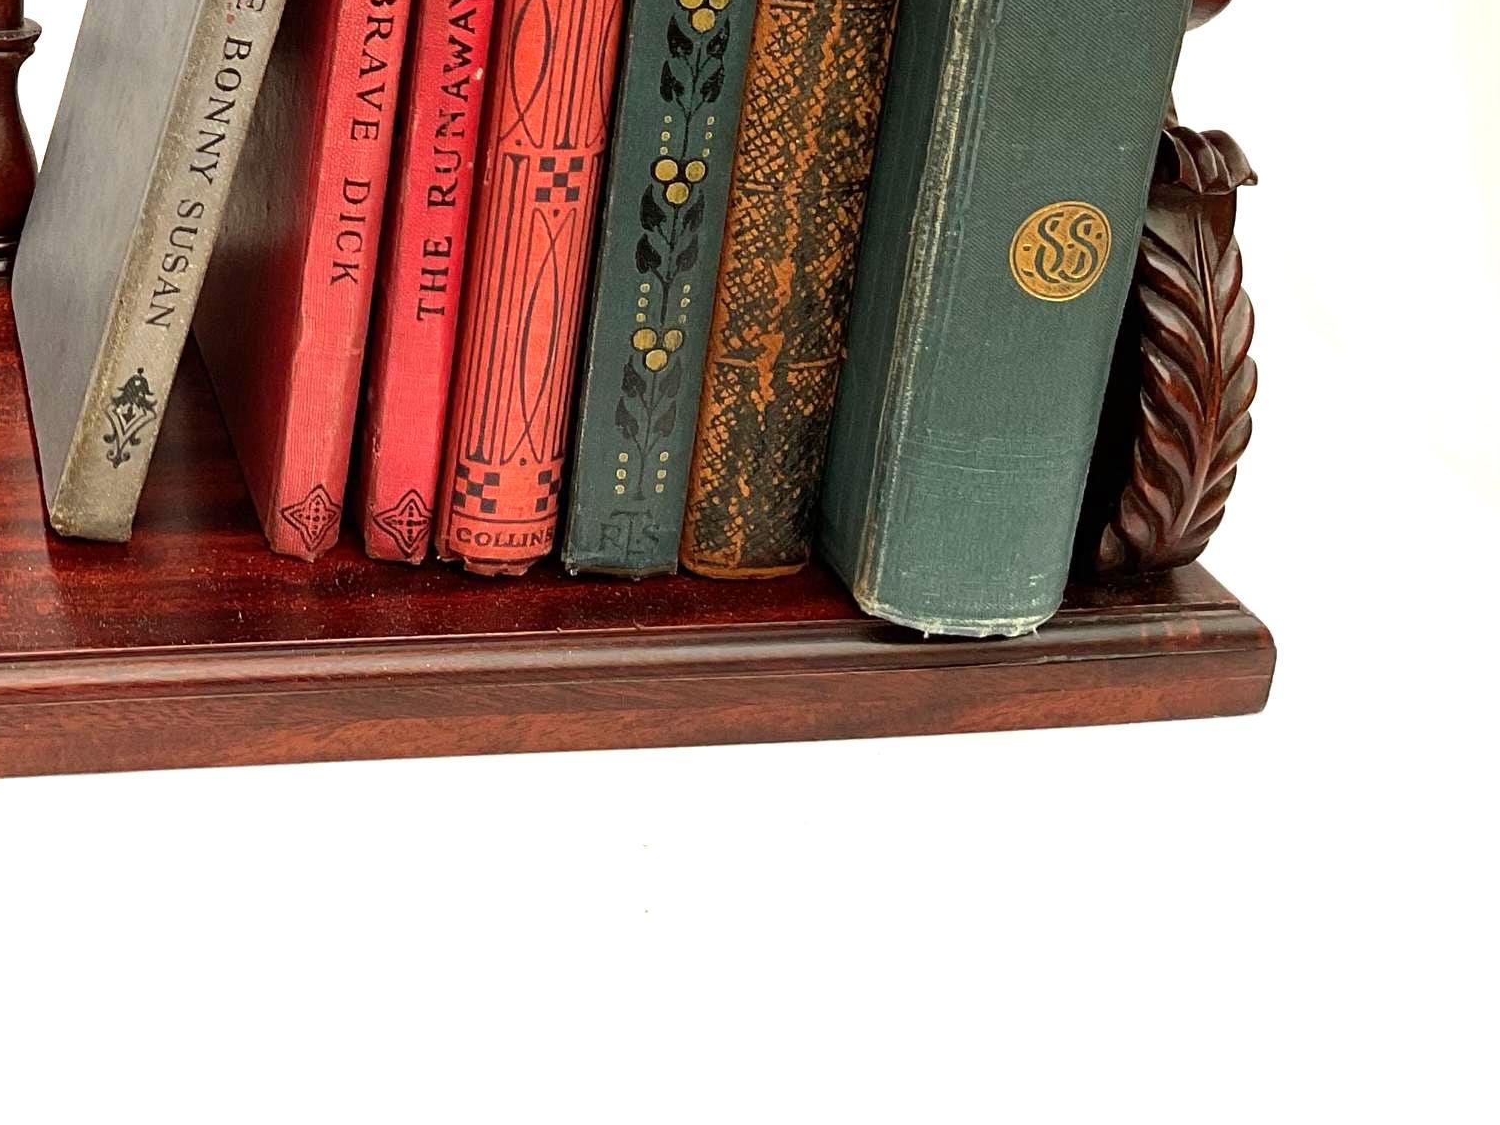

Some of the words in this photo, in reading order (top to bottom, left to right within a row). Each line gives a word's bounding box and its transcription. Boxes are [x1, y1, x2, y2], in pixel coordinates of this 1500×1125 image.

[189, 36, 253, 186] BONNY
[144, 198, 206, 331] SUSAN
[329, 176, 372, 287] DICK
[415, 235, 454, 323] THE
[455, 526, 554, 548] COLLINS
